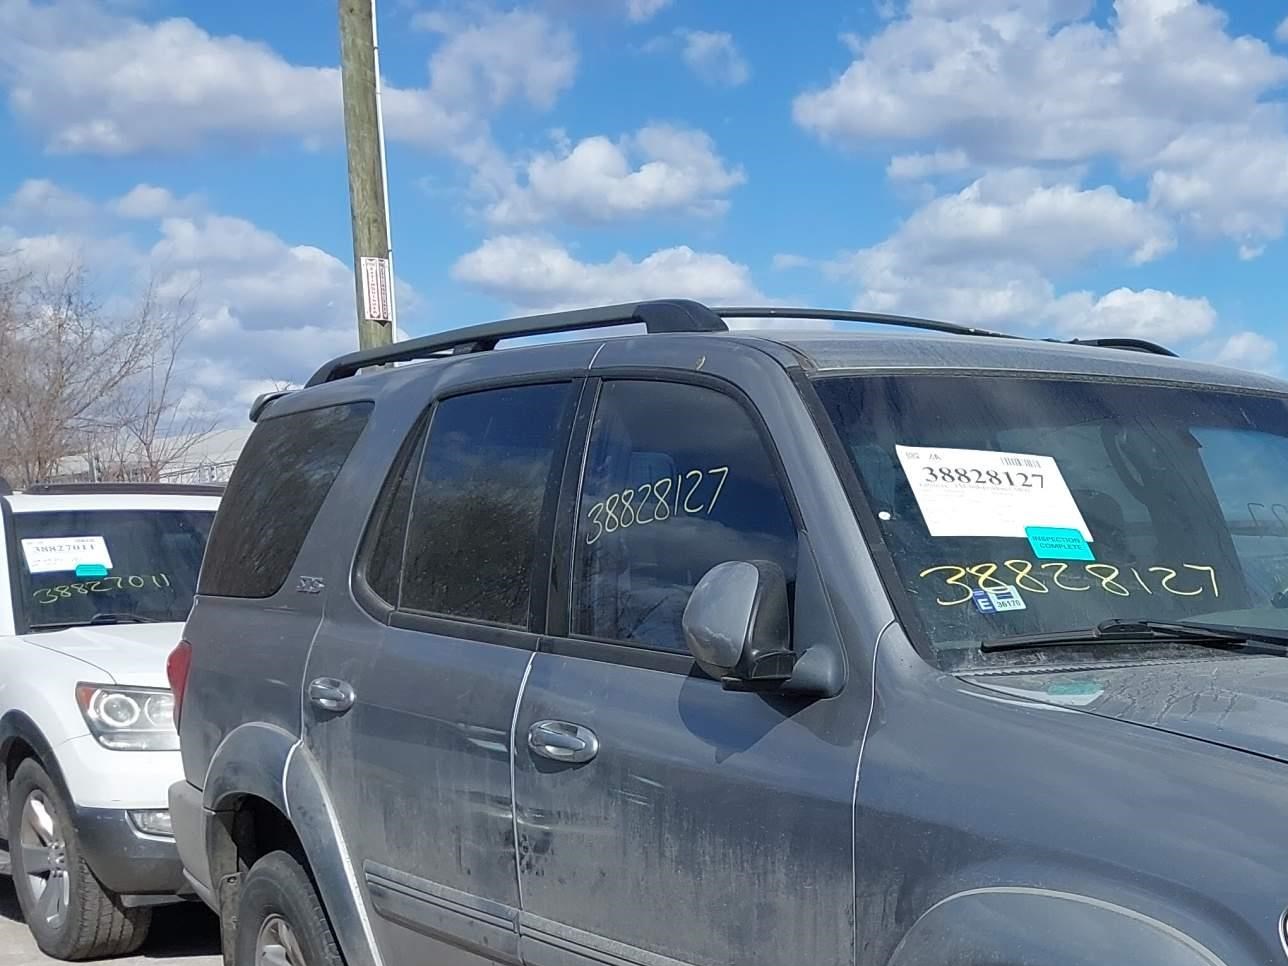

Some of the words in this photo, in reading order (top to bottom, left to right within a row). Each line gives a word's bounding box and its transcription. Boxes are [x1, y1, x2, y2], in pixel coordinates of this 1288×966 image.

[922, 466, 1044, 489] 38828127
[586, 467, 729, 544] 38828127
[1032, 535, 1081, 544] INSPECTION
[1040, 543, 1085, 551] COMPLETE
[33, 573, 170, 604] 38827011
[920, 559, 1219, 606] 38828127
